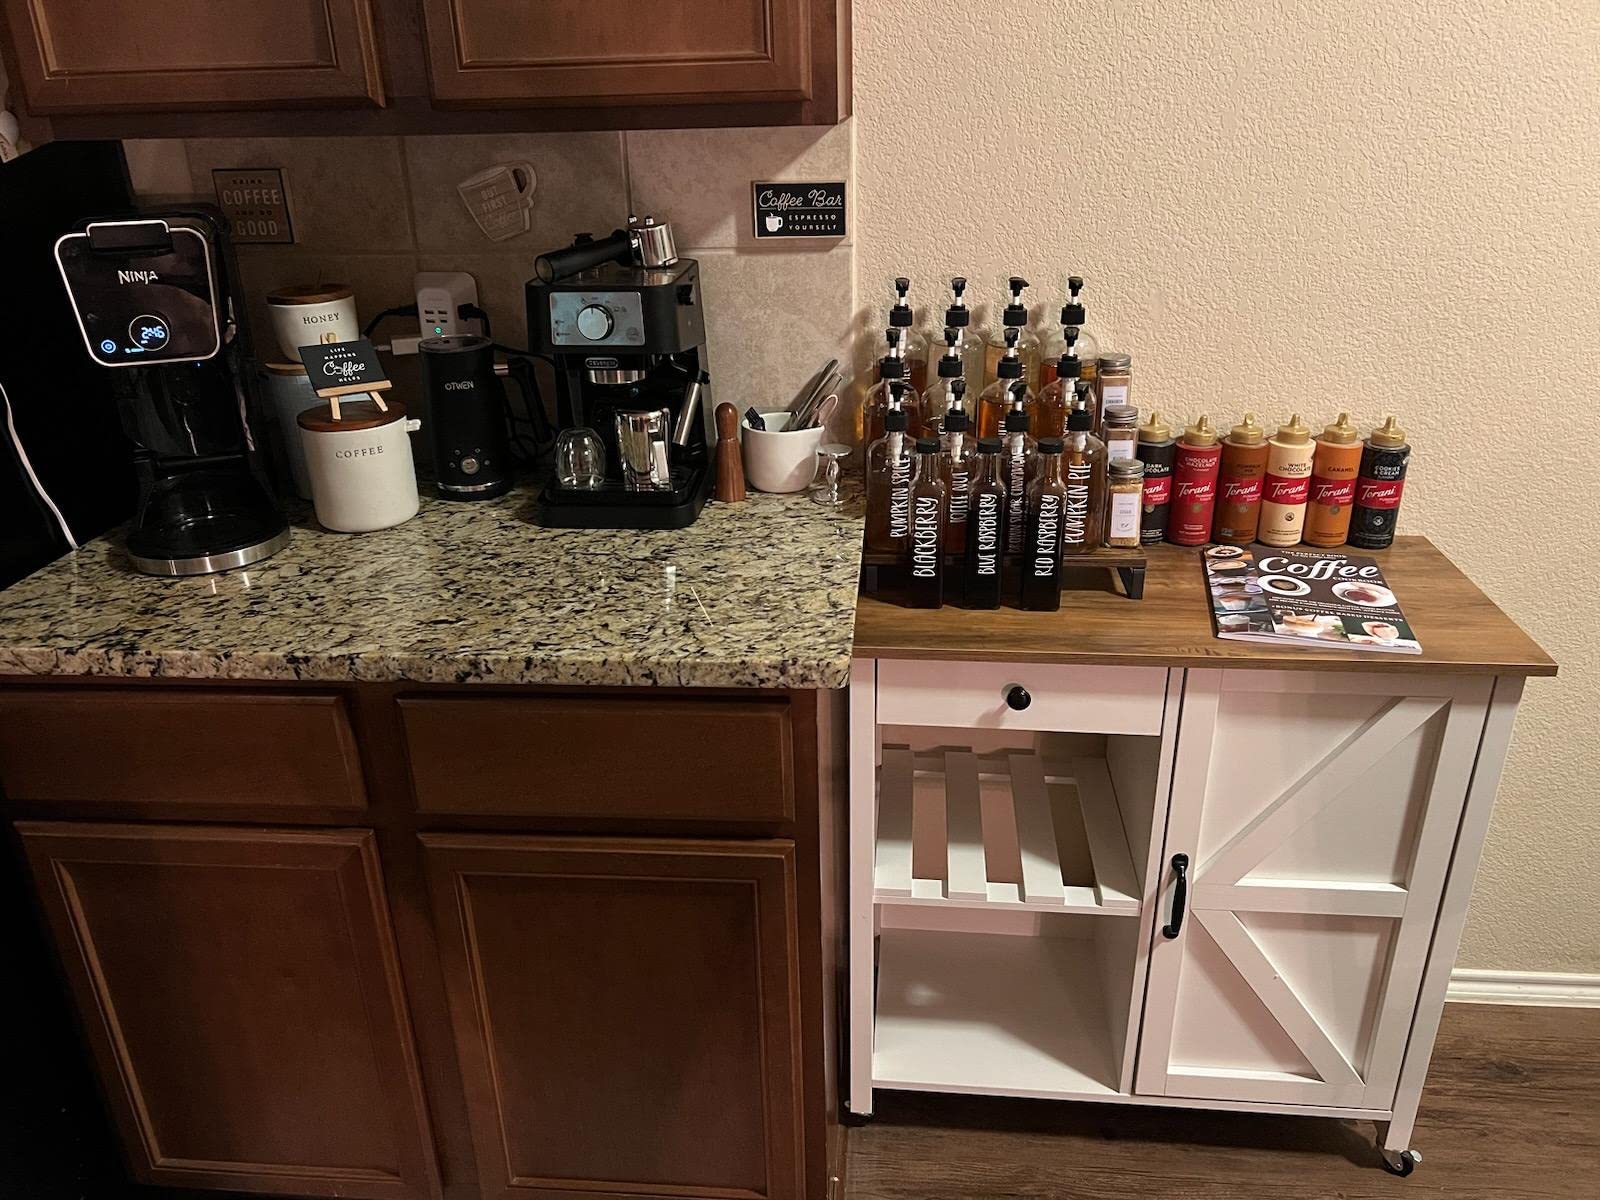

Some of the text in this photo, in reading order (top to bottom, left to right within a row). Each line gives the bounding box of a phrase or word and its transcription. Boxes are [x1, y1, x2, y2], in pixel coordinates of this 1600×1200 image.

[223, 189, 281, 205] COFFEE
[482, 195, 508, 213] FIRST
[759, 189, 843, 212] Coffee Bar
[237, 220, 278, 236] GOOD
[117, 270, 159, 285] NINJA
[302, 312, 340, 325] HONEY
[323, 361, 366, 376] Coffee
[335, 445, 384, 459] COFFEE
[1185, 456, 1218, 464] CHOCOLATE
[1143, 466, 1170, 474] OCOLATE
[890, 456, 911, 538] PUMPKIN SPICE
[1178, 481, 1212, 497] Torani
[1225, 481, 1259, 498] Torani
[1271, 481, 1306, 498] Torani
[1316, 483, 1351, 500] Torani
[1362, 485, 1396, 501] Torani
[1064, 460, 1092, 544] PUMPKIN PIE
[912, 497, 939, 577] BLACKBERRY
[977, 493, 998, 575] BLUE RASPBERRY
[1034, 494, 1060, 577] RED RASPBERRY
[1258, 556, 1379, 581] Coffee
[1332, 576, 1384, 585] COOKBOOK
[1363, 614, 1404, 622] DESSERTS
